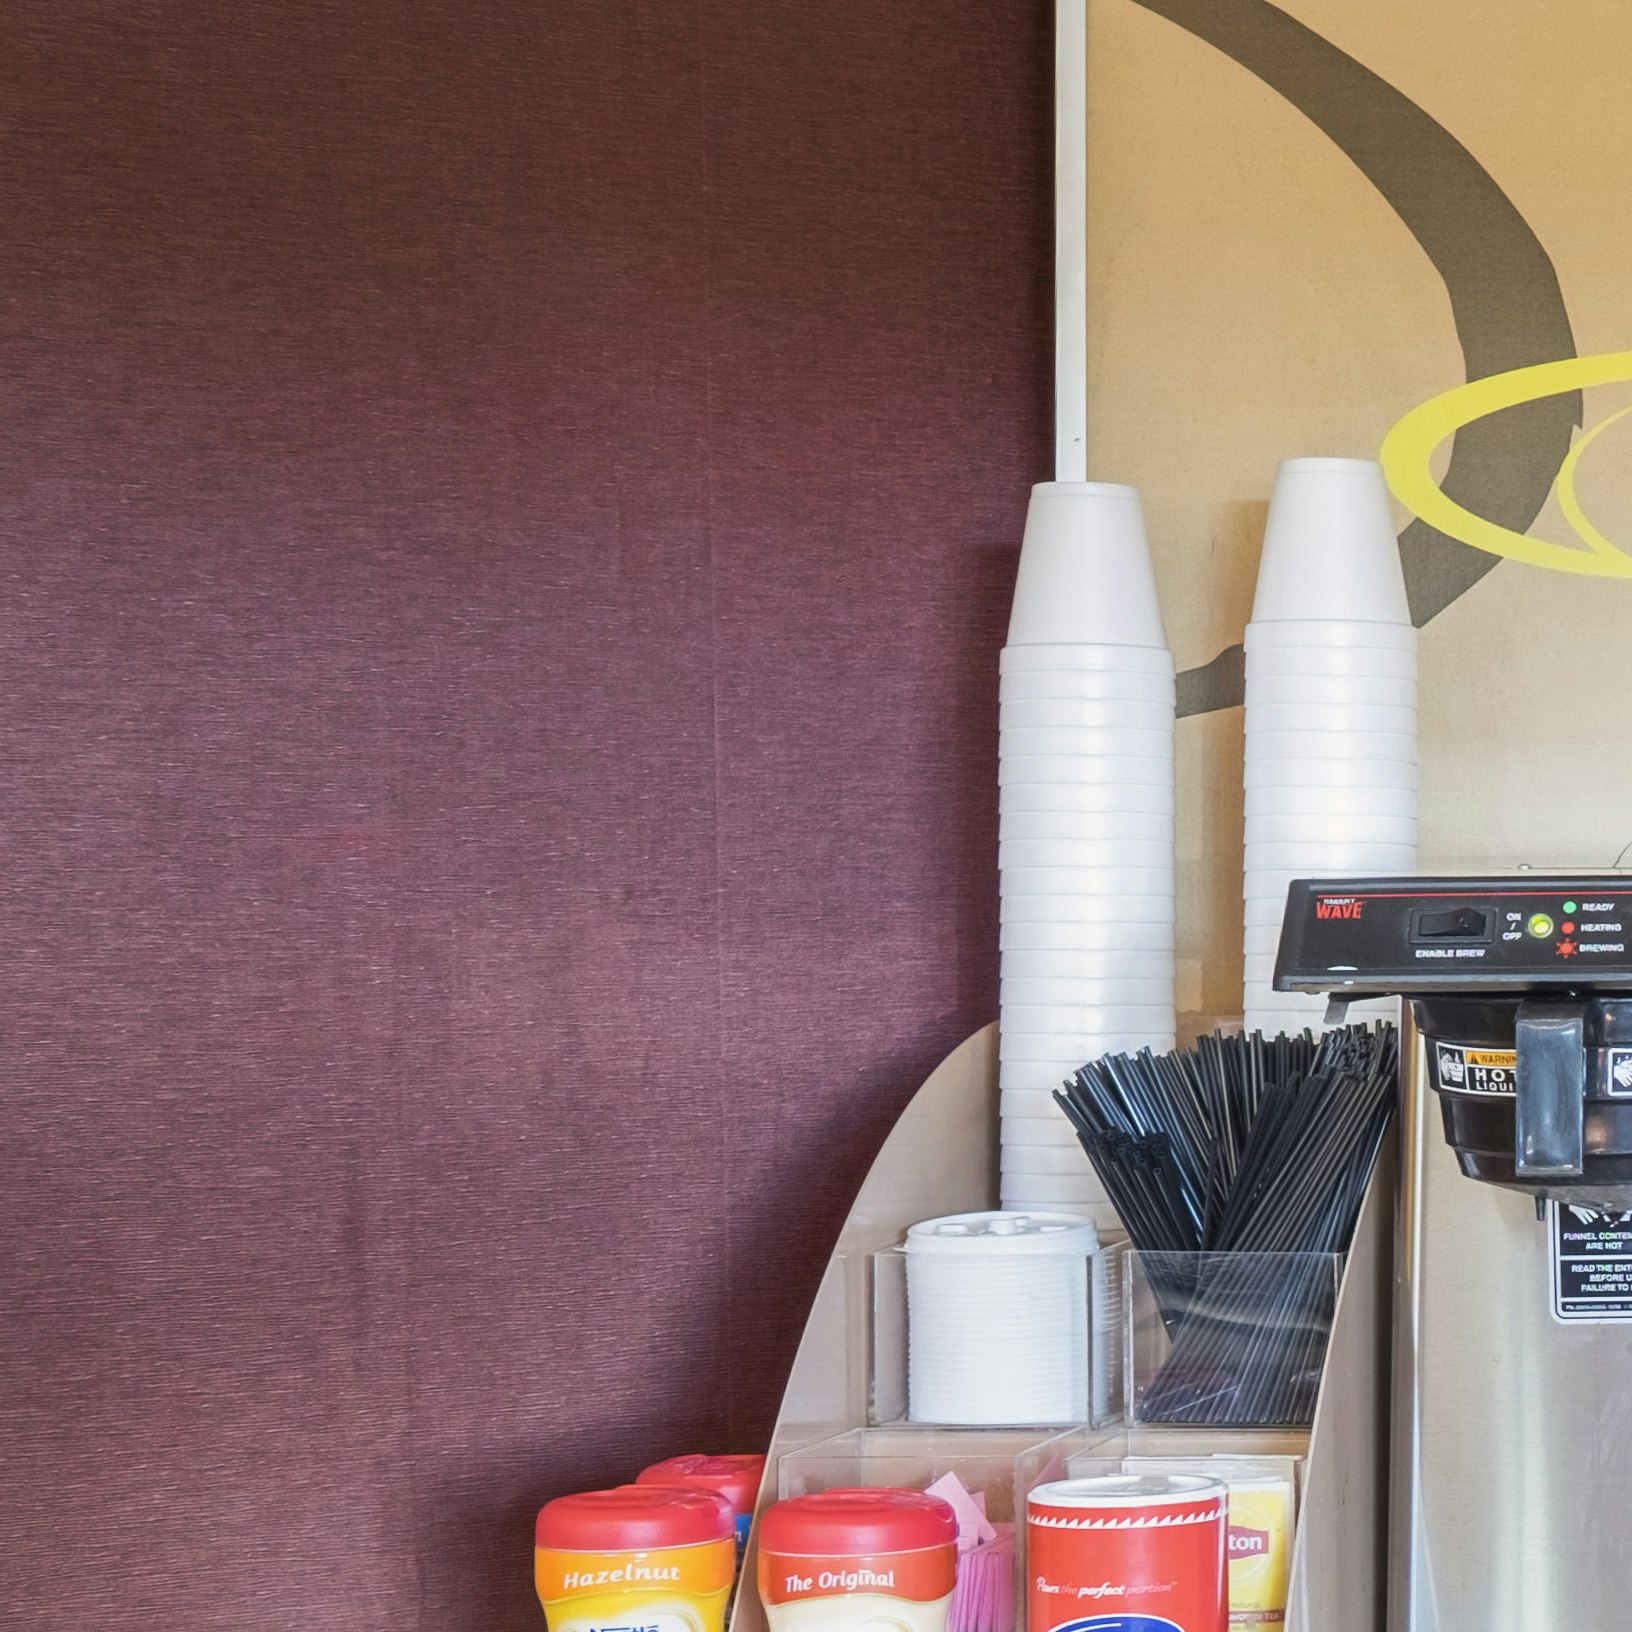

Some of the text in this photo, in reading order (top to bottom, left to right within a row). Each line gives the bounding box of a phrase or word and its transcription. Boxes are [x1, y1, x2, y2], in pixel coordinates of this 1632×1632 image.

[1316, 901, 1363, 919] WAVE
[1582, 903, 1615, 912] READY
[1506, 912, 1522, 922] ON
[1580, 923, 1622, 932] HEATING
[1502, 932, 1522, 941] OFF
[1579, 943, 1625, 953] BREWING
[1415, 949, 1486, 959] ENABLE BREW
[1479, 1054, 1516, 1064] WARNIN
[1476, 1080, 1516, 1091] LIQUI
[1563, 1232, 1597, 1241] FUNNEL
[1585, 1242, 1624, 1250] ARE HOT
[1589, 1274, 1625, 1282] BEFORE
[1581, 1284, 1617, 1292] FAILURE
[563, 1563, 680, 1590] Hazelnut
[785, 1569, 895, 1593] The Original
[1077, 1581, 1126, 1599] perfect
